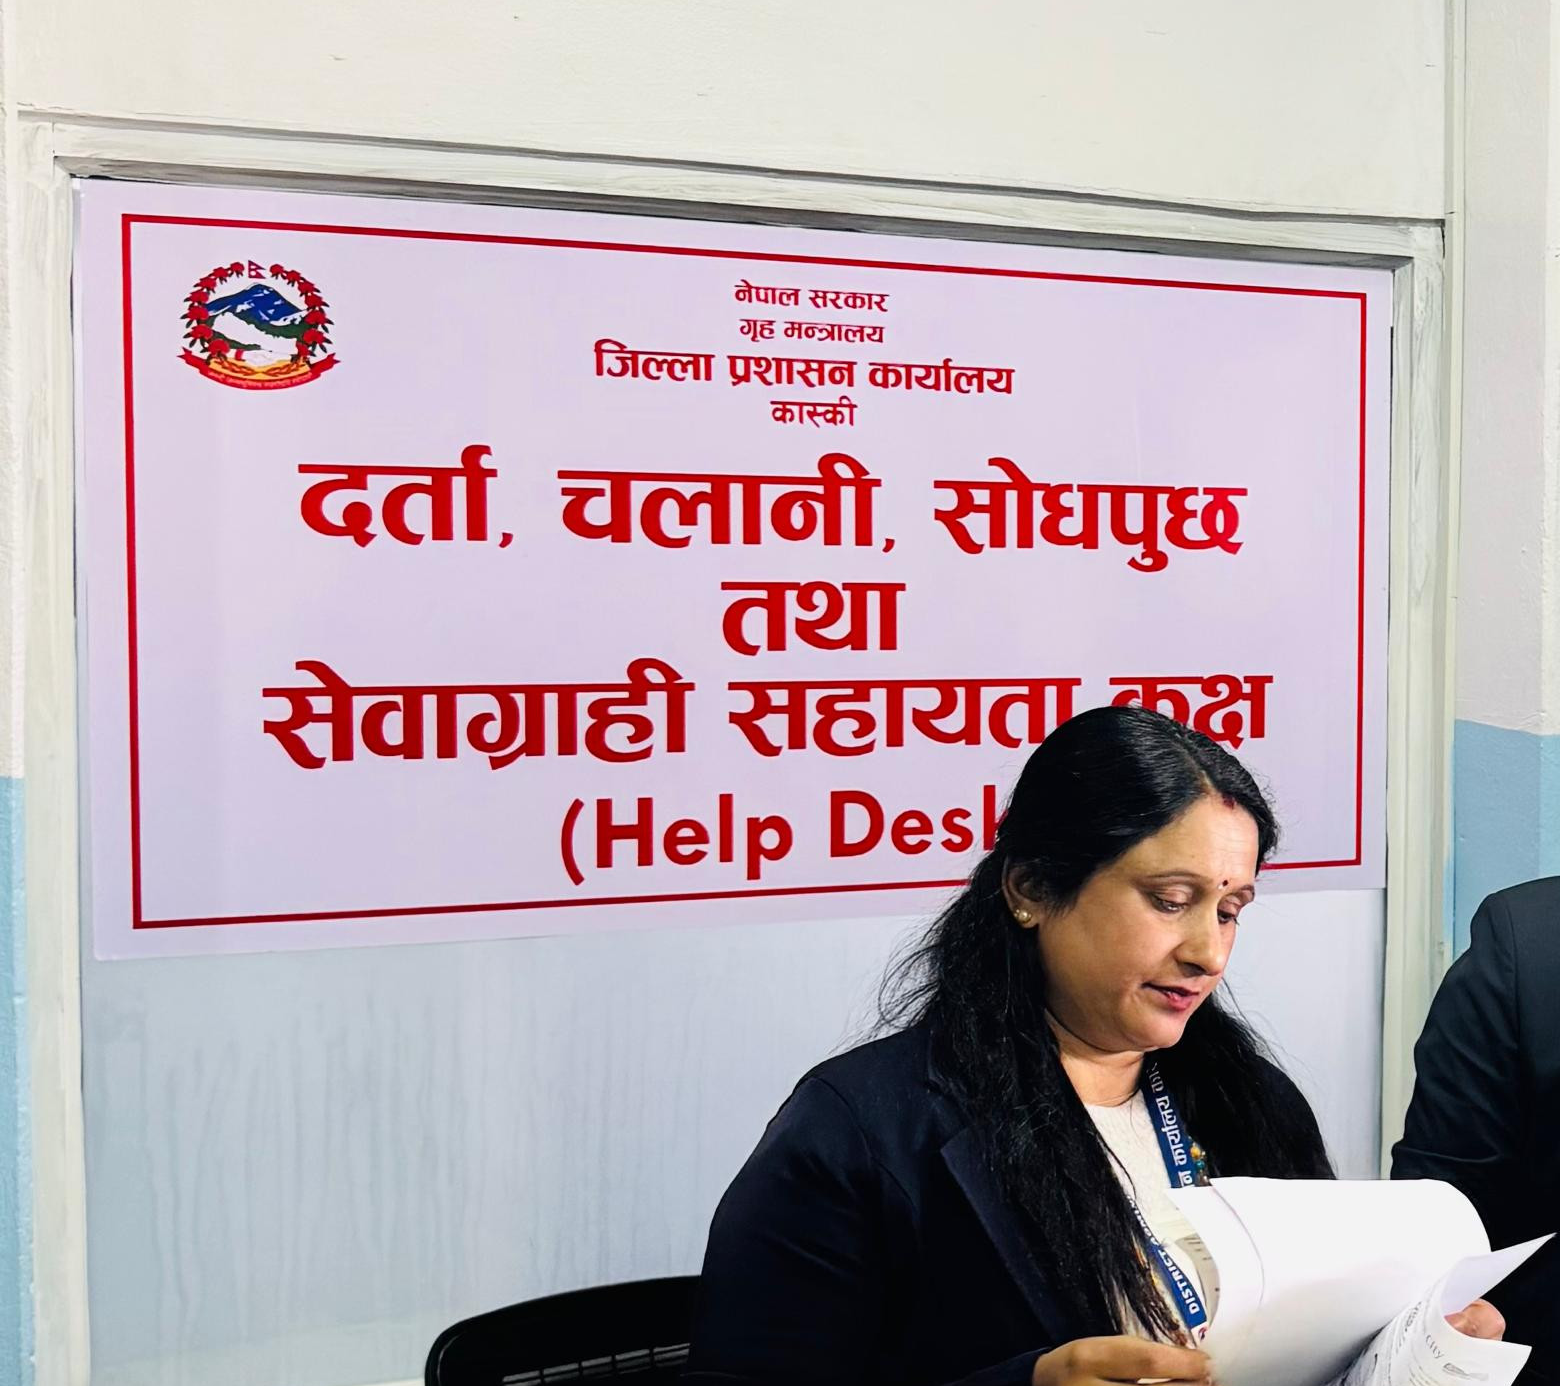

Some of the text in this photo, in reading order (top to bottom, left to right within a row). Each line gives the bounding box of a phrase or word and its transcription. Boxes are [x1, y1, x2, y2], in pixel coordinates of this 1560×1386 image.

[734, 279, 888, 313] नेपाल सरकार
[739, 318, 884, 344] गृह मन्त्रालय
[593, 338, 1016, 396] जिल्ला प्रशासन कार्यालय
[770, 395, 857, 428] कास्की
[297, 444, 1249, 574] दर्ता, चलानी, सोधपुछ
[720, 580, 908, 657] तथा
[261, 657, 697, 771] सेवाग्राही
[727, 676, 1083, 758] सहायता
[559, 792, 794, 886] (Help
[1156, 1095, 1188, 1167] कार्यालय
[1157, 1248, 1201, 1315] DISTRICT
